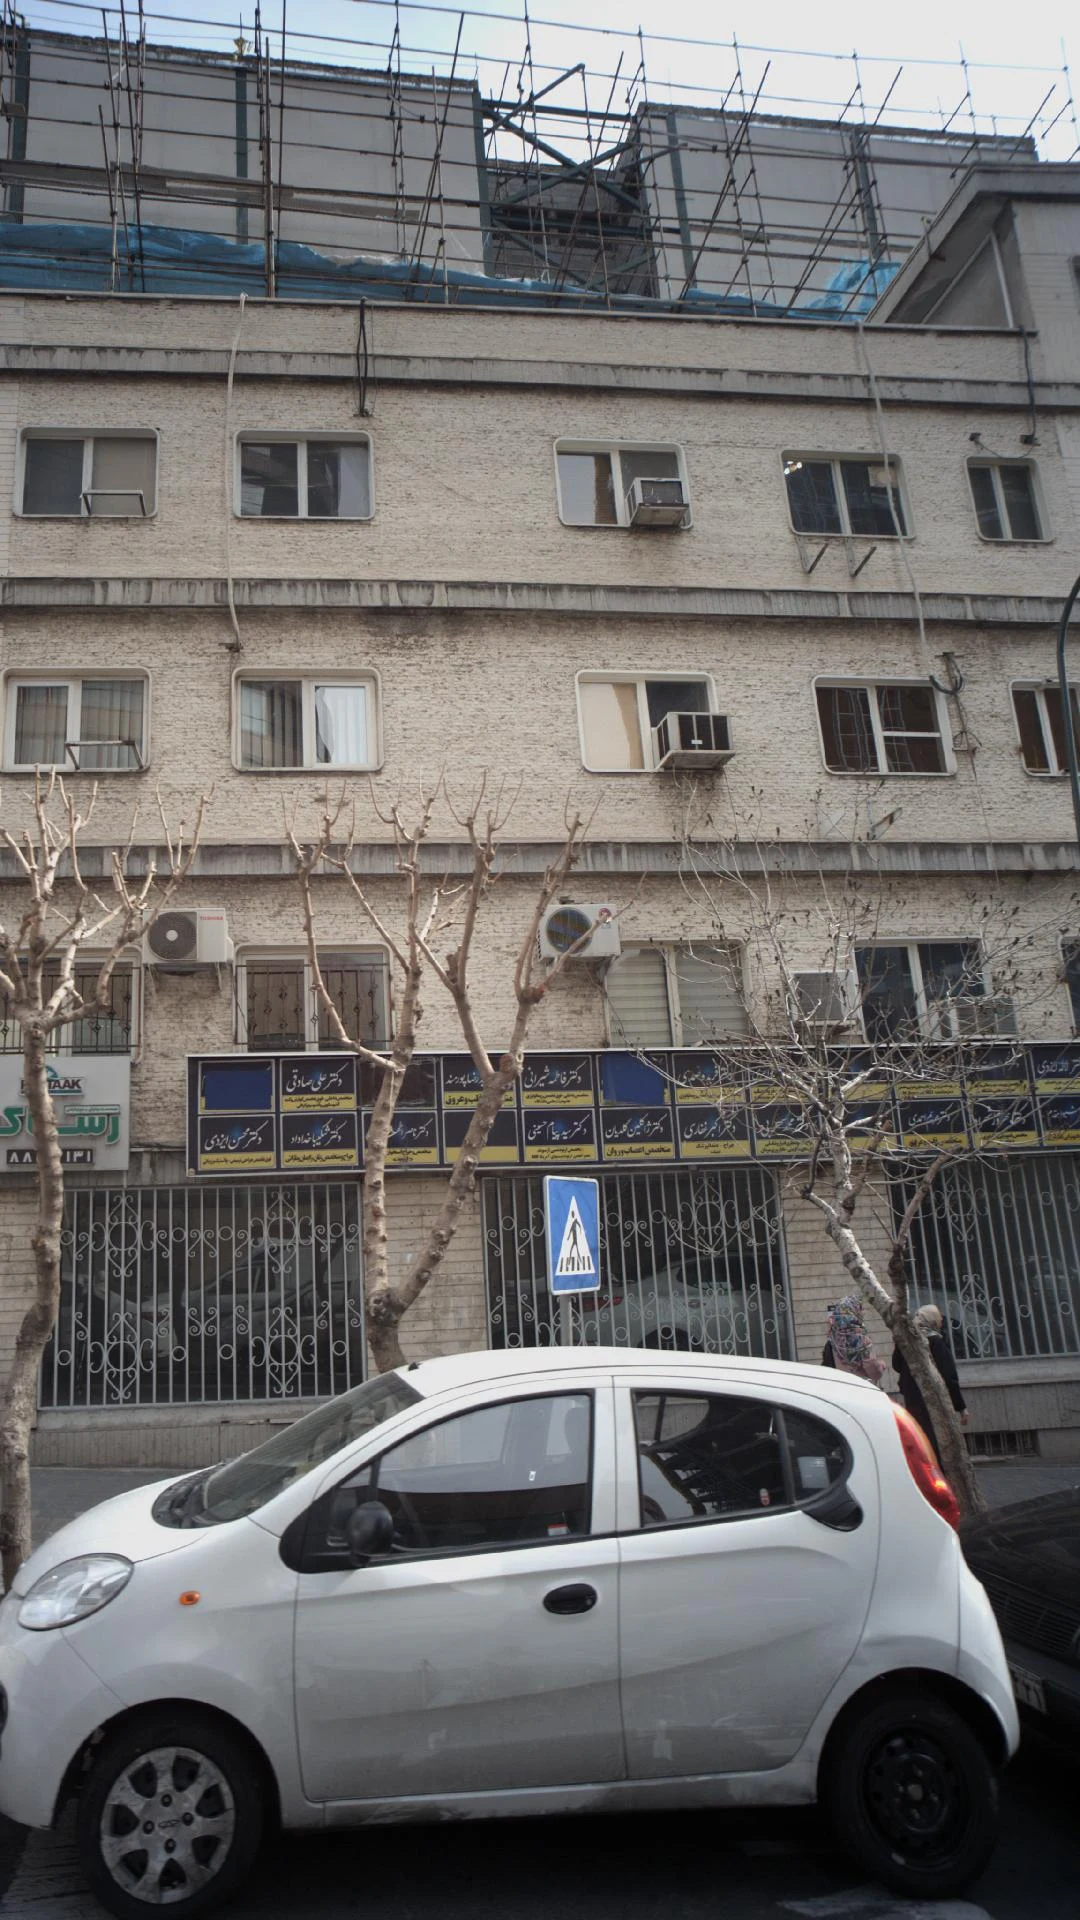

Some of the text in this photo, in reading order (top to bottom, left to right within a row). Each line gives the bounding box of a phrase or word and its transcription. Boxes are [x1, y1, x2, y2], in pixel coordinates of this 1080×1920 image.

[286, 1061, 350, 1093] دکتر علی صادقی
[562, 1059, 588, 1088] دکتر
[0, 1107, 120, 1144] رساک
[227, 1127, 250, 1150] محسن
[241, 1120, 268, 1149] دکتر
[325, 1120, 348, 1147] دکتر
[414, 1118, 433, 1140] دکتر
[569, 1112, 592, 1139] دکتر
[649, 1113, 668, 1137] دکتر
[683, 1121, 707, 1139] غفاری
[9, 1150, 91, 1163] ۸۸۱۳۱
